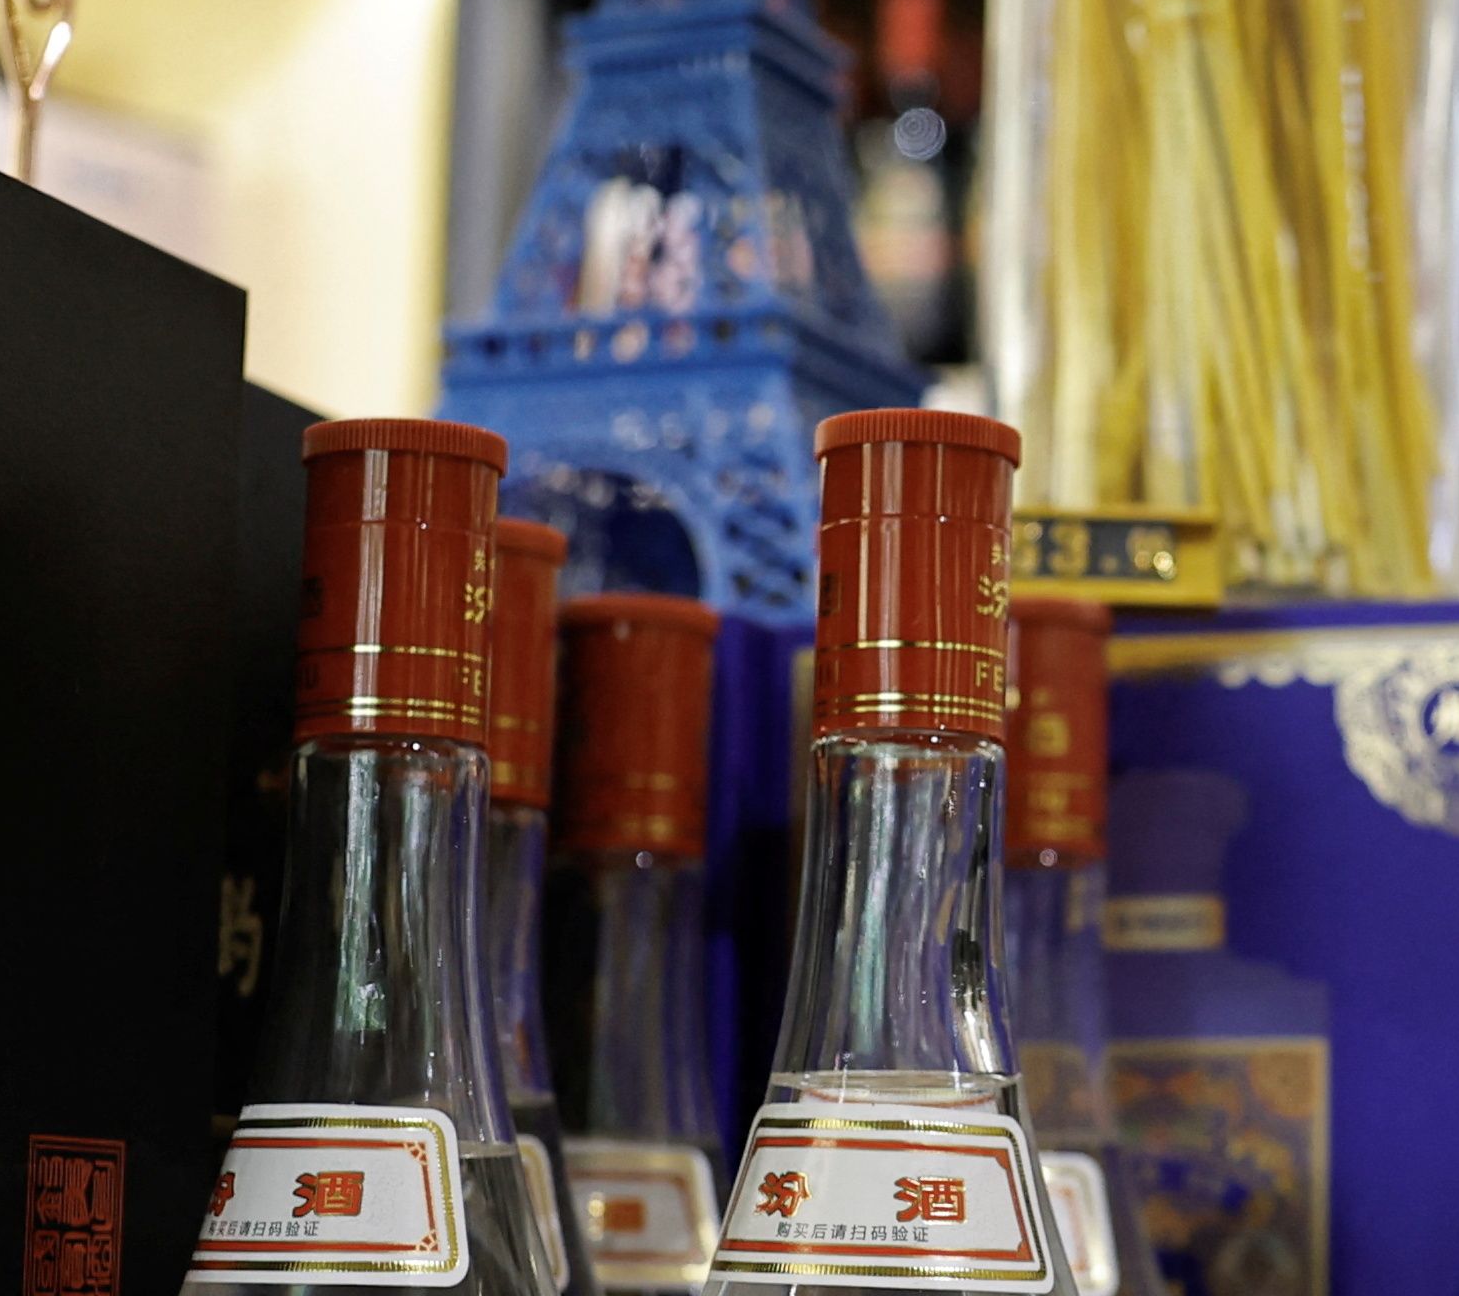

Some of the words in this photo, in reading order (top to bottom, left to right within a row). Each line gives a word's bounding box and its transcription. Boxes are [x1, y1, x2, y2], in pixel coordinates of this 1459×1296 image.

[292, 1170, 365, 1218] 酒
[775, 1220, 930, 1244] 购买后请扫码验证
